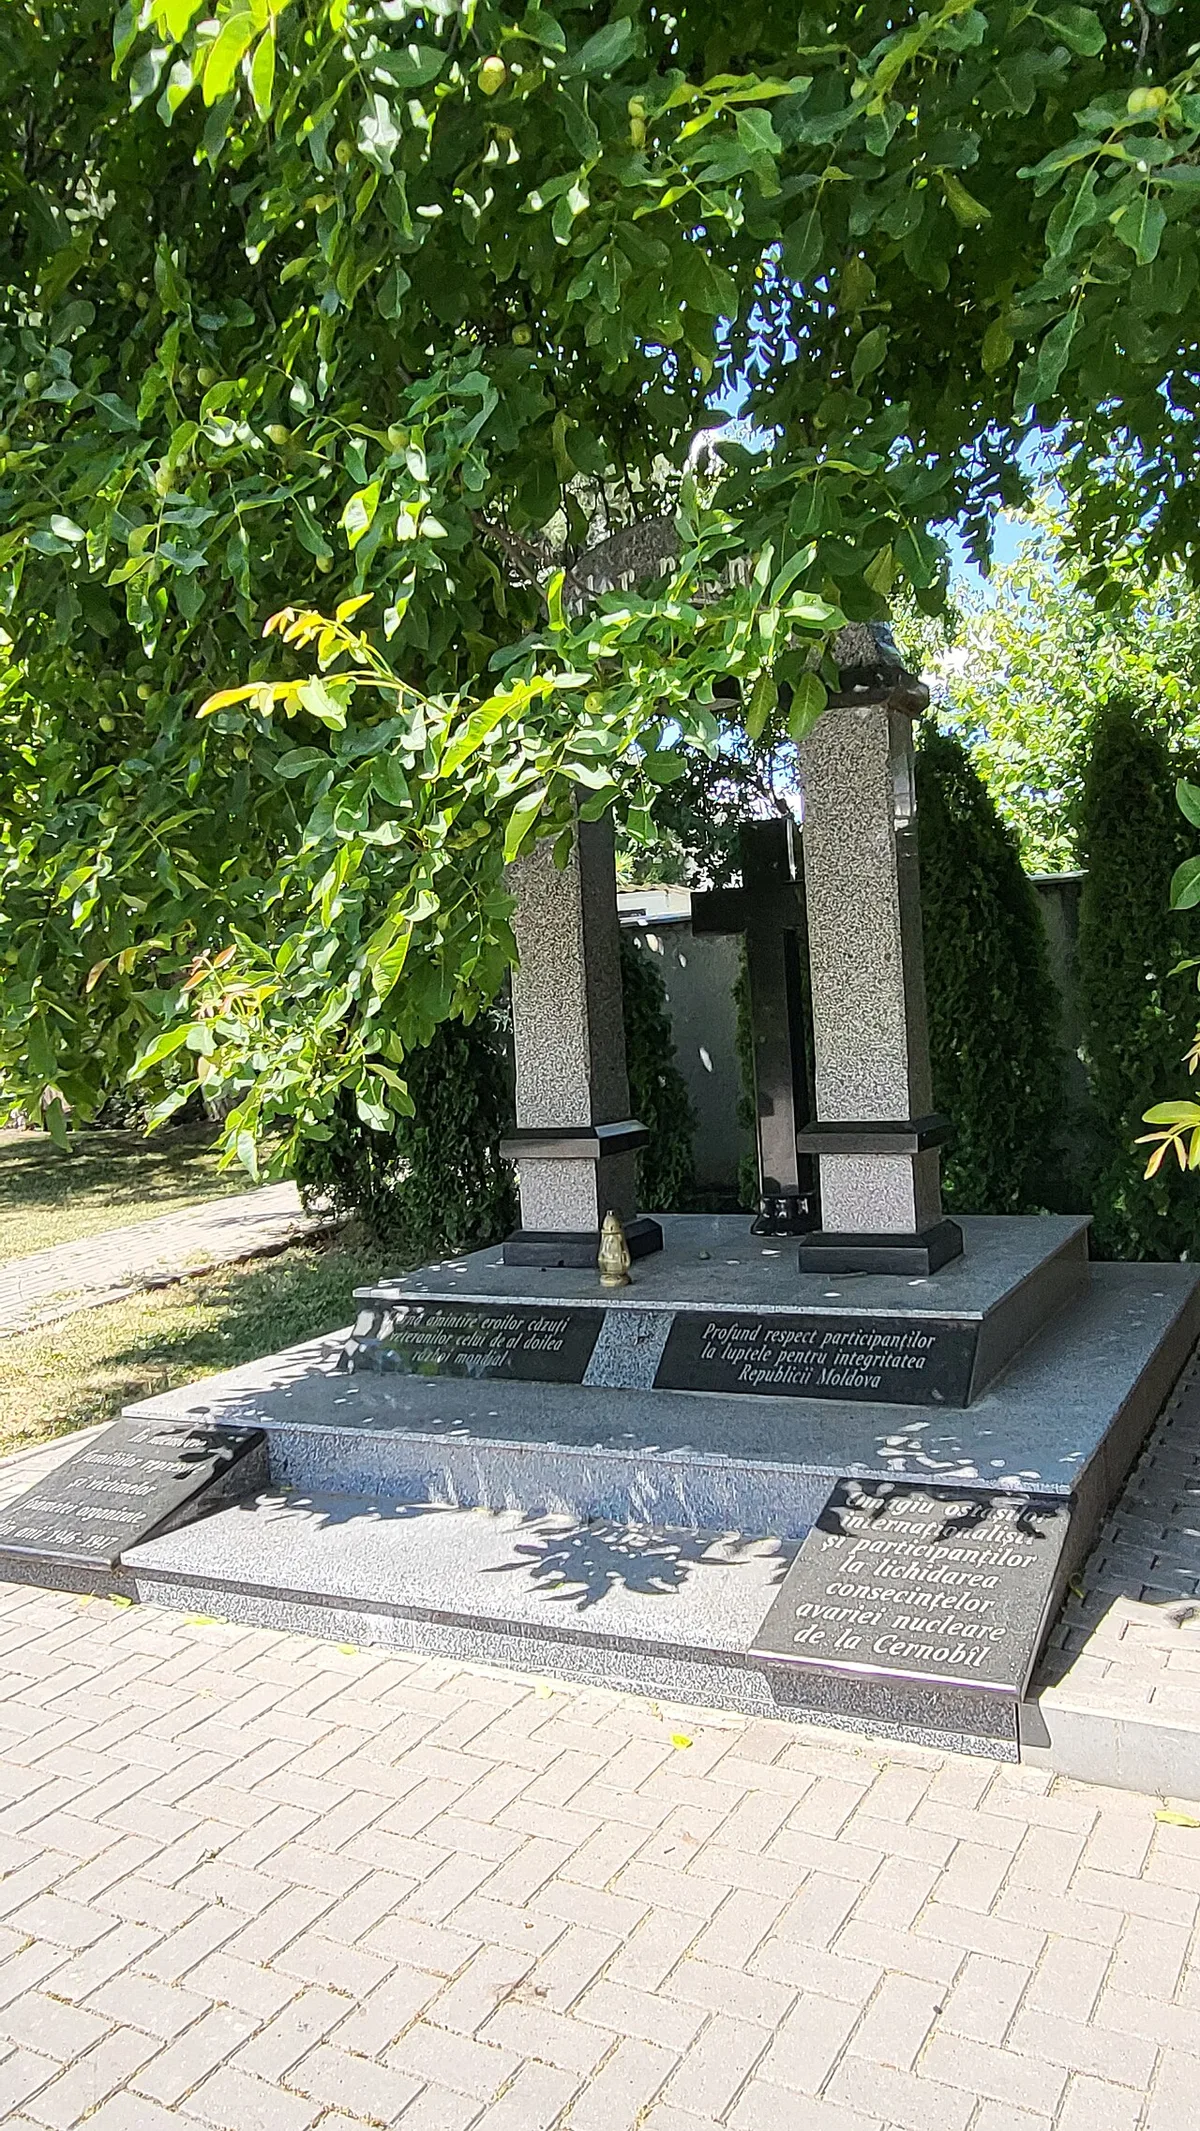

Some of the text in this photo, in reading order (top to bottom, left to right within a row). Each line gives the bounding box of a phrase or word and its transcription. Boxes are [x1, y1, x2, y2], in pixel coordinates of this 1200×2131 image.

[426, 1312, 479, 1328] amintire
[481, 1314, 524, 1330] eroilor
[527, 1316, 570, 1336] căzuți
[702, 1323, 936, 1352] Profund respect participanților
[389, 1329, 563, 1351] veteranilor celui de al doilea
[454, 1349, 509, 1367] mondial
[701, 1342, 926, 1371] la luptele pentru integritatea
[738, 1364, 882, 1388] Republicii Moldova
[70, 1448, 144, 1468] familiilor
[86, 1476, 157, 1497] victimelor
[10, 1495, 147, 1523] foametei organizate
[14, 1525, 54, 1540] anii
[848, 1538, 1038, 1568] participanților
[839, 1554, 1000, 1589] la lichidarea
[826, 1581, 995, 1613] consecințelor
[796, 1602, 1007, 1641] avariei nucleare
[793, 1624, 991, 1667] de la Cernobîl
